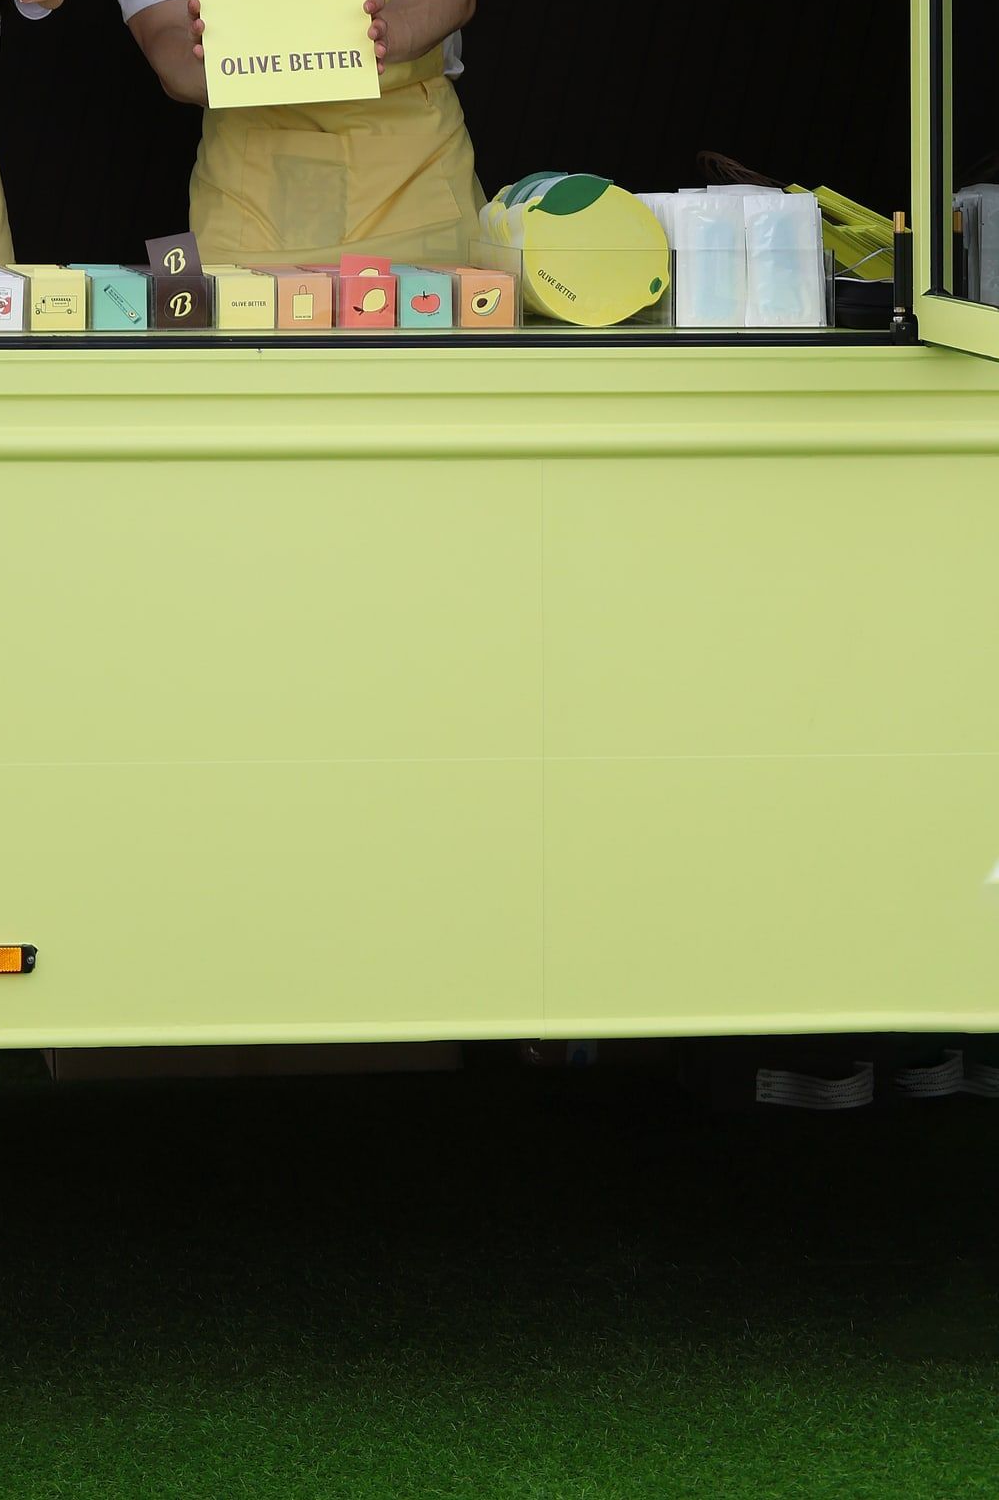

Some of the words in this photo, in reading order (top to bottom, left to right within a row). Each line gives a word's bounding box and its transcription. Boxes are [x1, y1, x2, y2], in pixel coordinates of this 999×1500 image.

[221, 54, 282, 75] OLIVE
[289, 50, 363, 72] BETTER
[163, 247, 186, 275] B
[537, 269, 556, 286] OLIVE
[554, 282, 577, 301] BETTER
[169, 291, 192, 317] B
